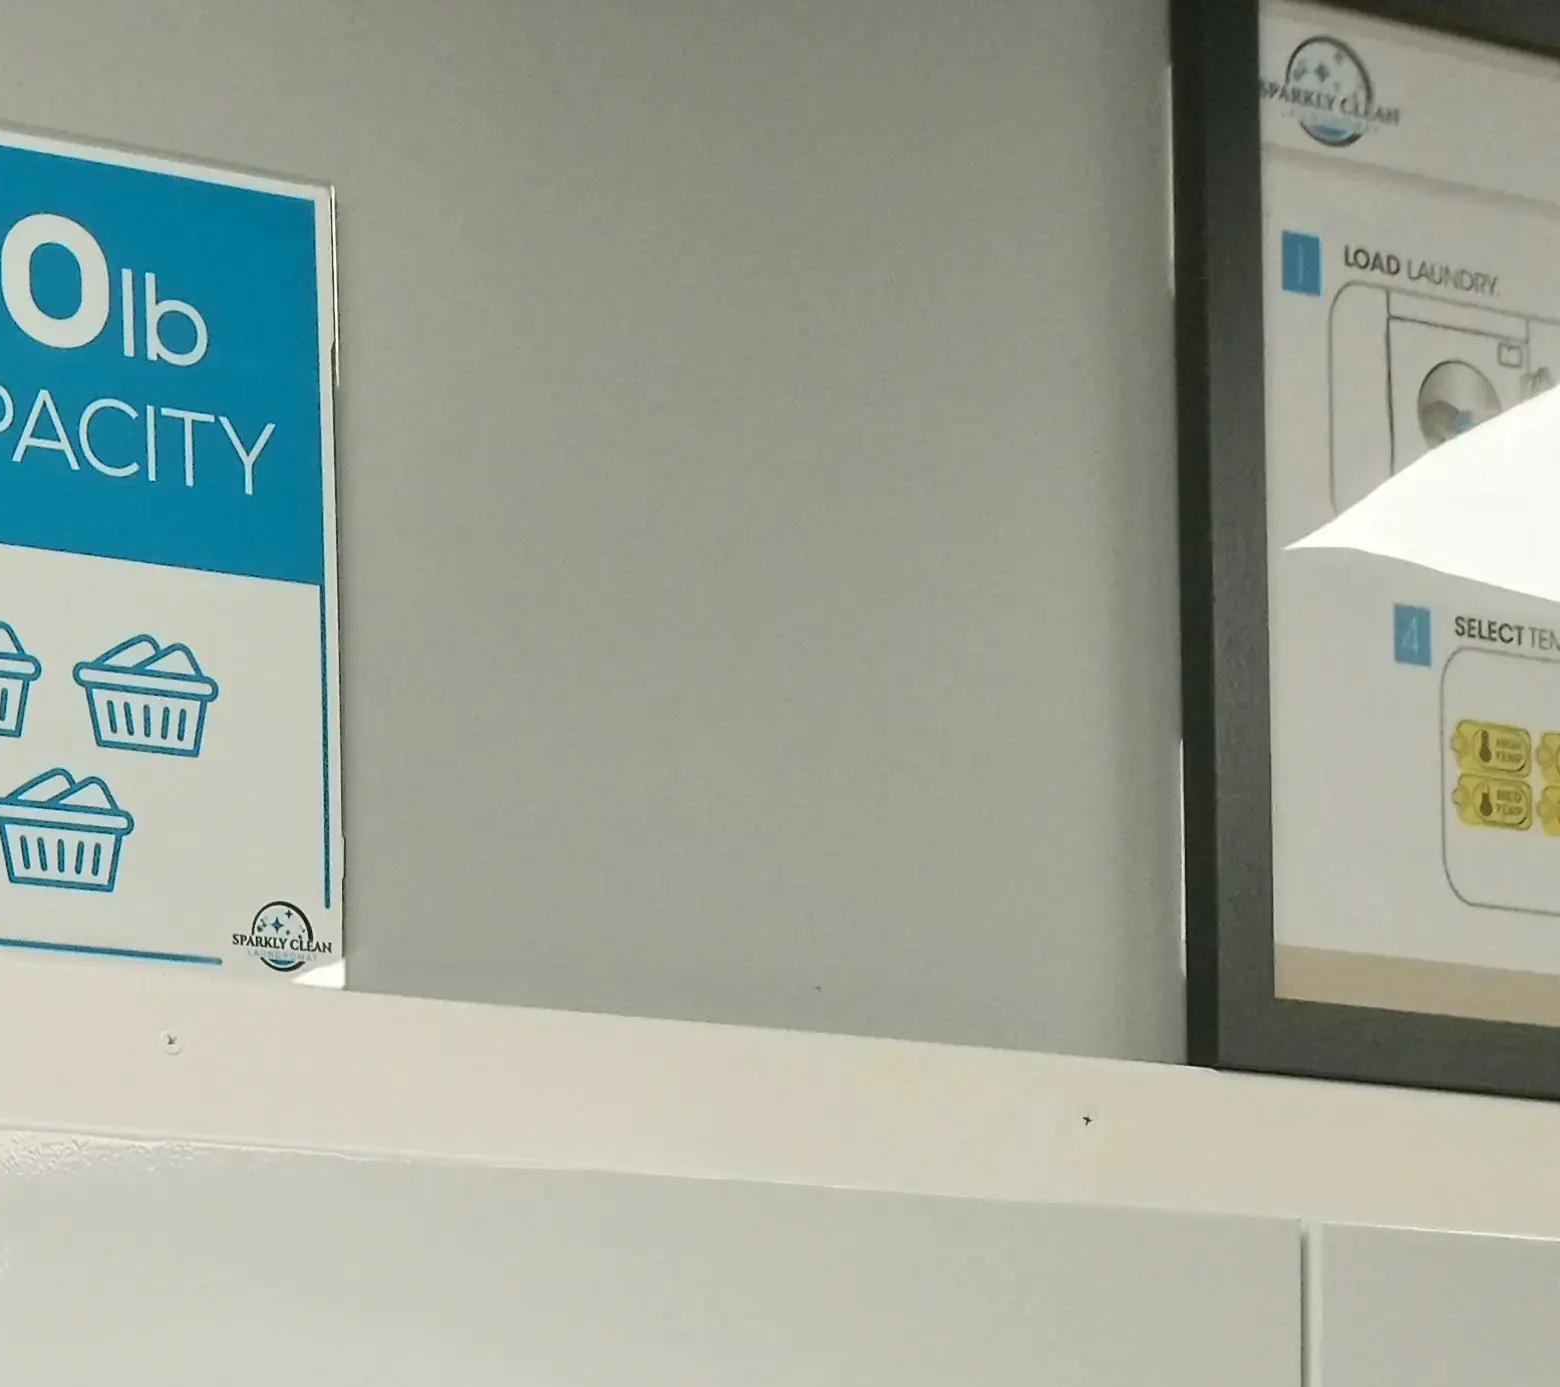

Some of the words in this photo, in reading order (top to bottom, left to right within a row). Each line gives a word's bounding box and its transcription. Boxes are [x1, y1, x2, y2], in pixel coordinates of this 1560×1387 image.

[1344, 245, 1400, 276] LOAD
[1454, 615, 1525, 646] SELECT
[232, 933, 288, 950] SPARKLY
[290, 938, 332, 953] CLEAN
